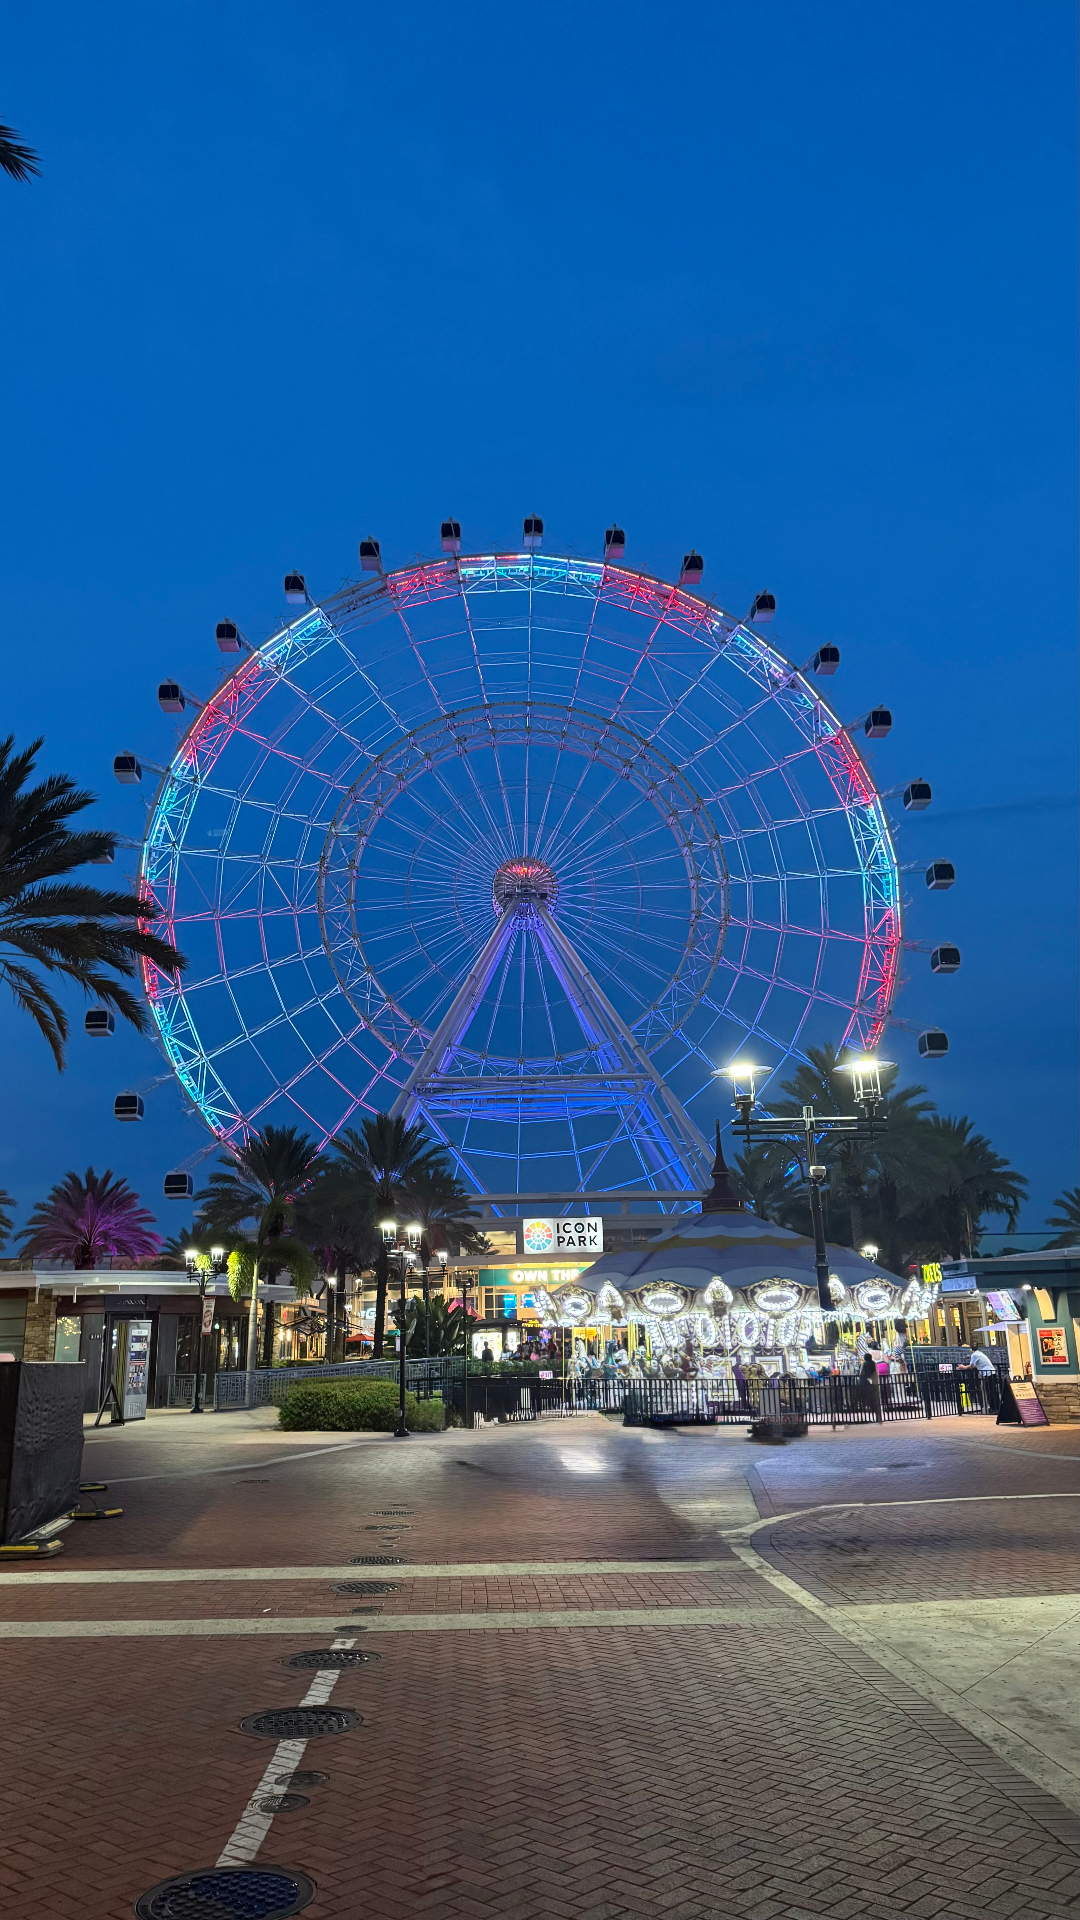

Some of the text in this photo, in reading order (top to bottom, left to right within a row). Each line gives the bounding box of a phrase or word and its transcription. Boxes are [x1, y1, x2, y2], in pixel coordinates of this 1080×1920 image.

[556, 1222, 598, 1234] ICON
[556, 1235, 598, 1247] PARK
[512, 1270, 548, 1282] OWN
